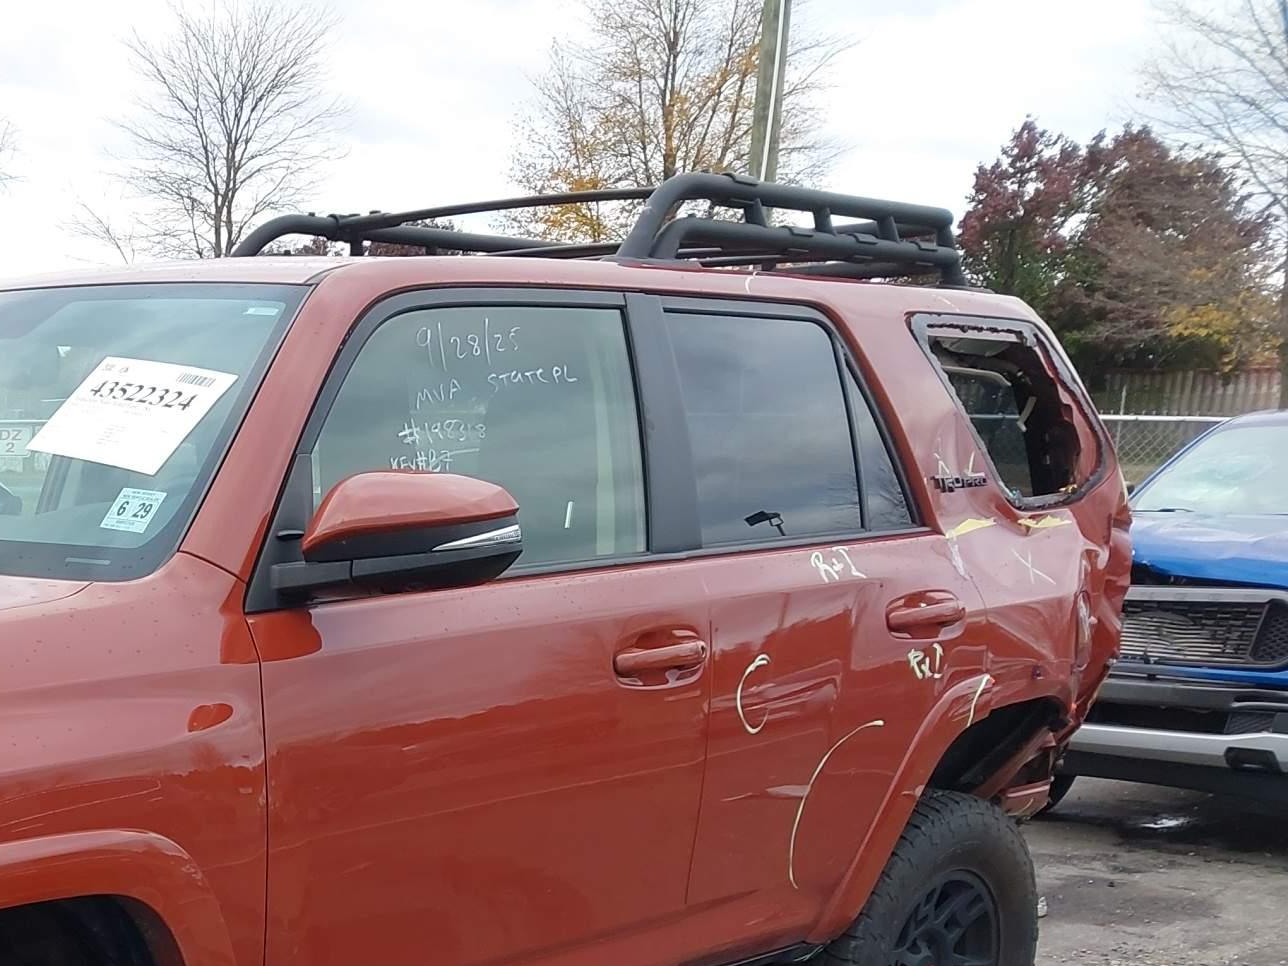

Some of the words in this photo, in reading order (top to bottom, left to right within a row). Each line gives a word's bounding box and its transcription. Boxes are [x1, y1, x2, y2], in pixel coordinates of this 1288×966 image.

[416, 318, 521, 372] 9/28/25
[89, 380, 198, 411] 43522324
[416, 378, 462, 410] MVA
[0, 429, 23, 441] DZ
[5, 442, 15, 453] 2
[116, 500, 130, 517] 6
[132, 502, 153, 519] 29
